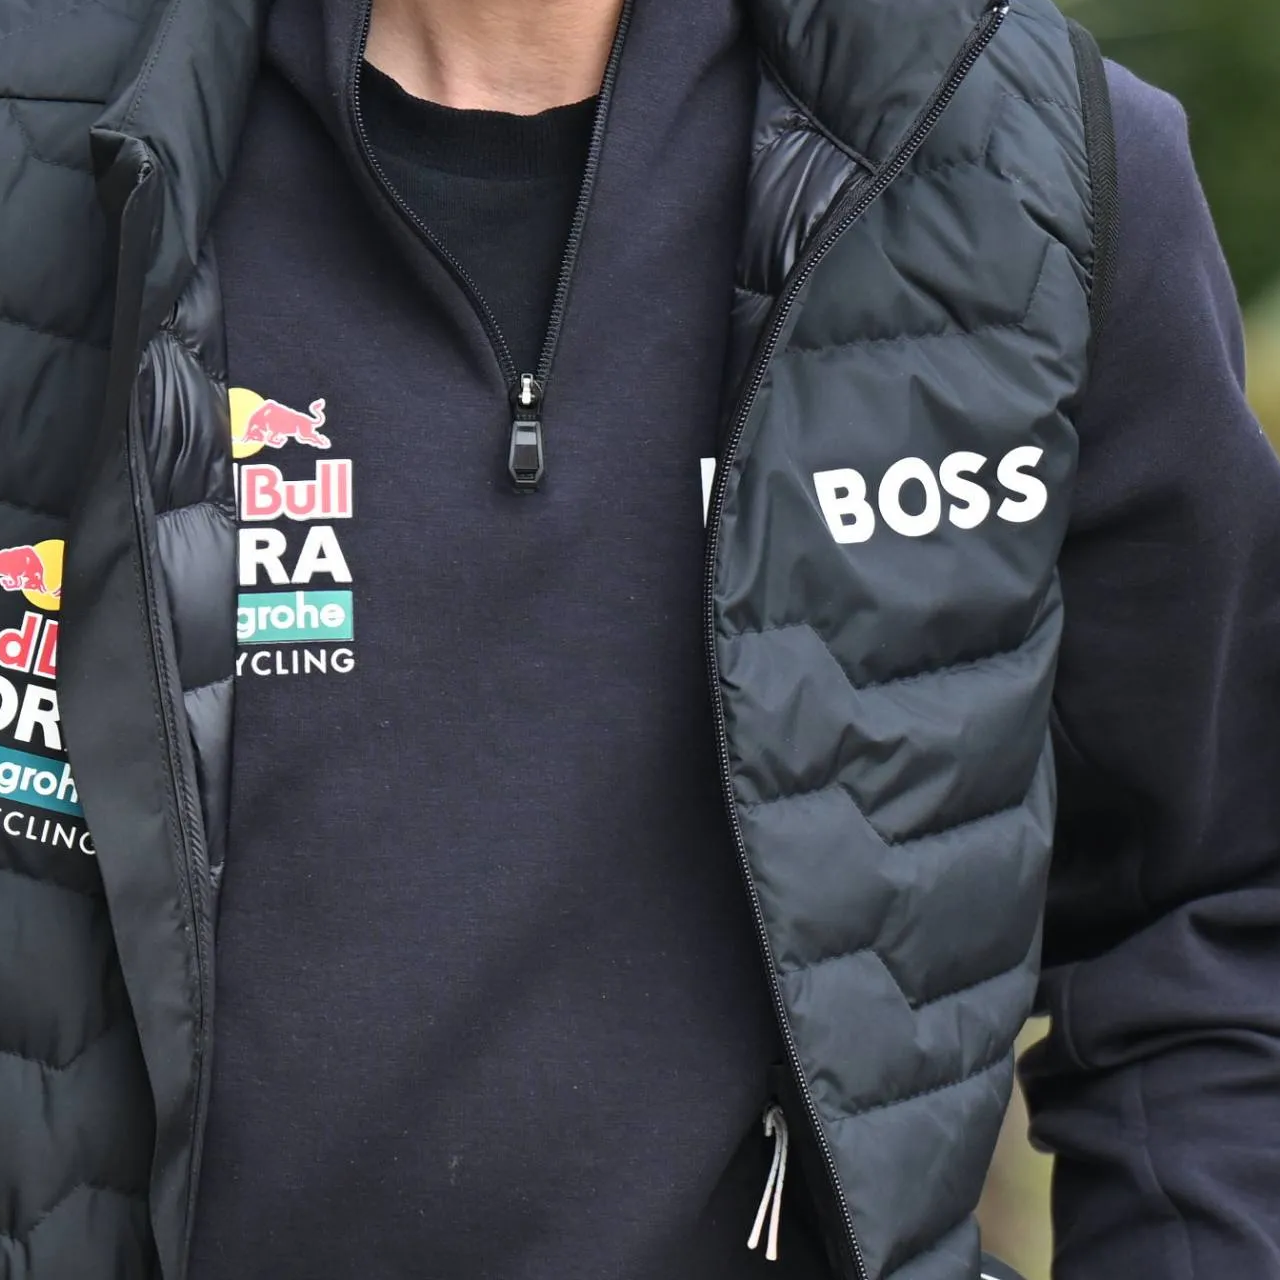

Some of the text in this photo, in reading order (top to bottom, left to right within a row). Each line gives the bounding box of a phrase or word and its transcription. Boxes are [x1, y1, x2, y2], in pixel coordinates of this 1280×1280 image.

[241, 459, 352, 521] Bull
[813, 446, 1048, 544] BOSS
[239, 525, 353, 586] RA
[237, 591, 345, 639] grohe
[236, 648, 355, 677] YCLING
